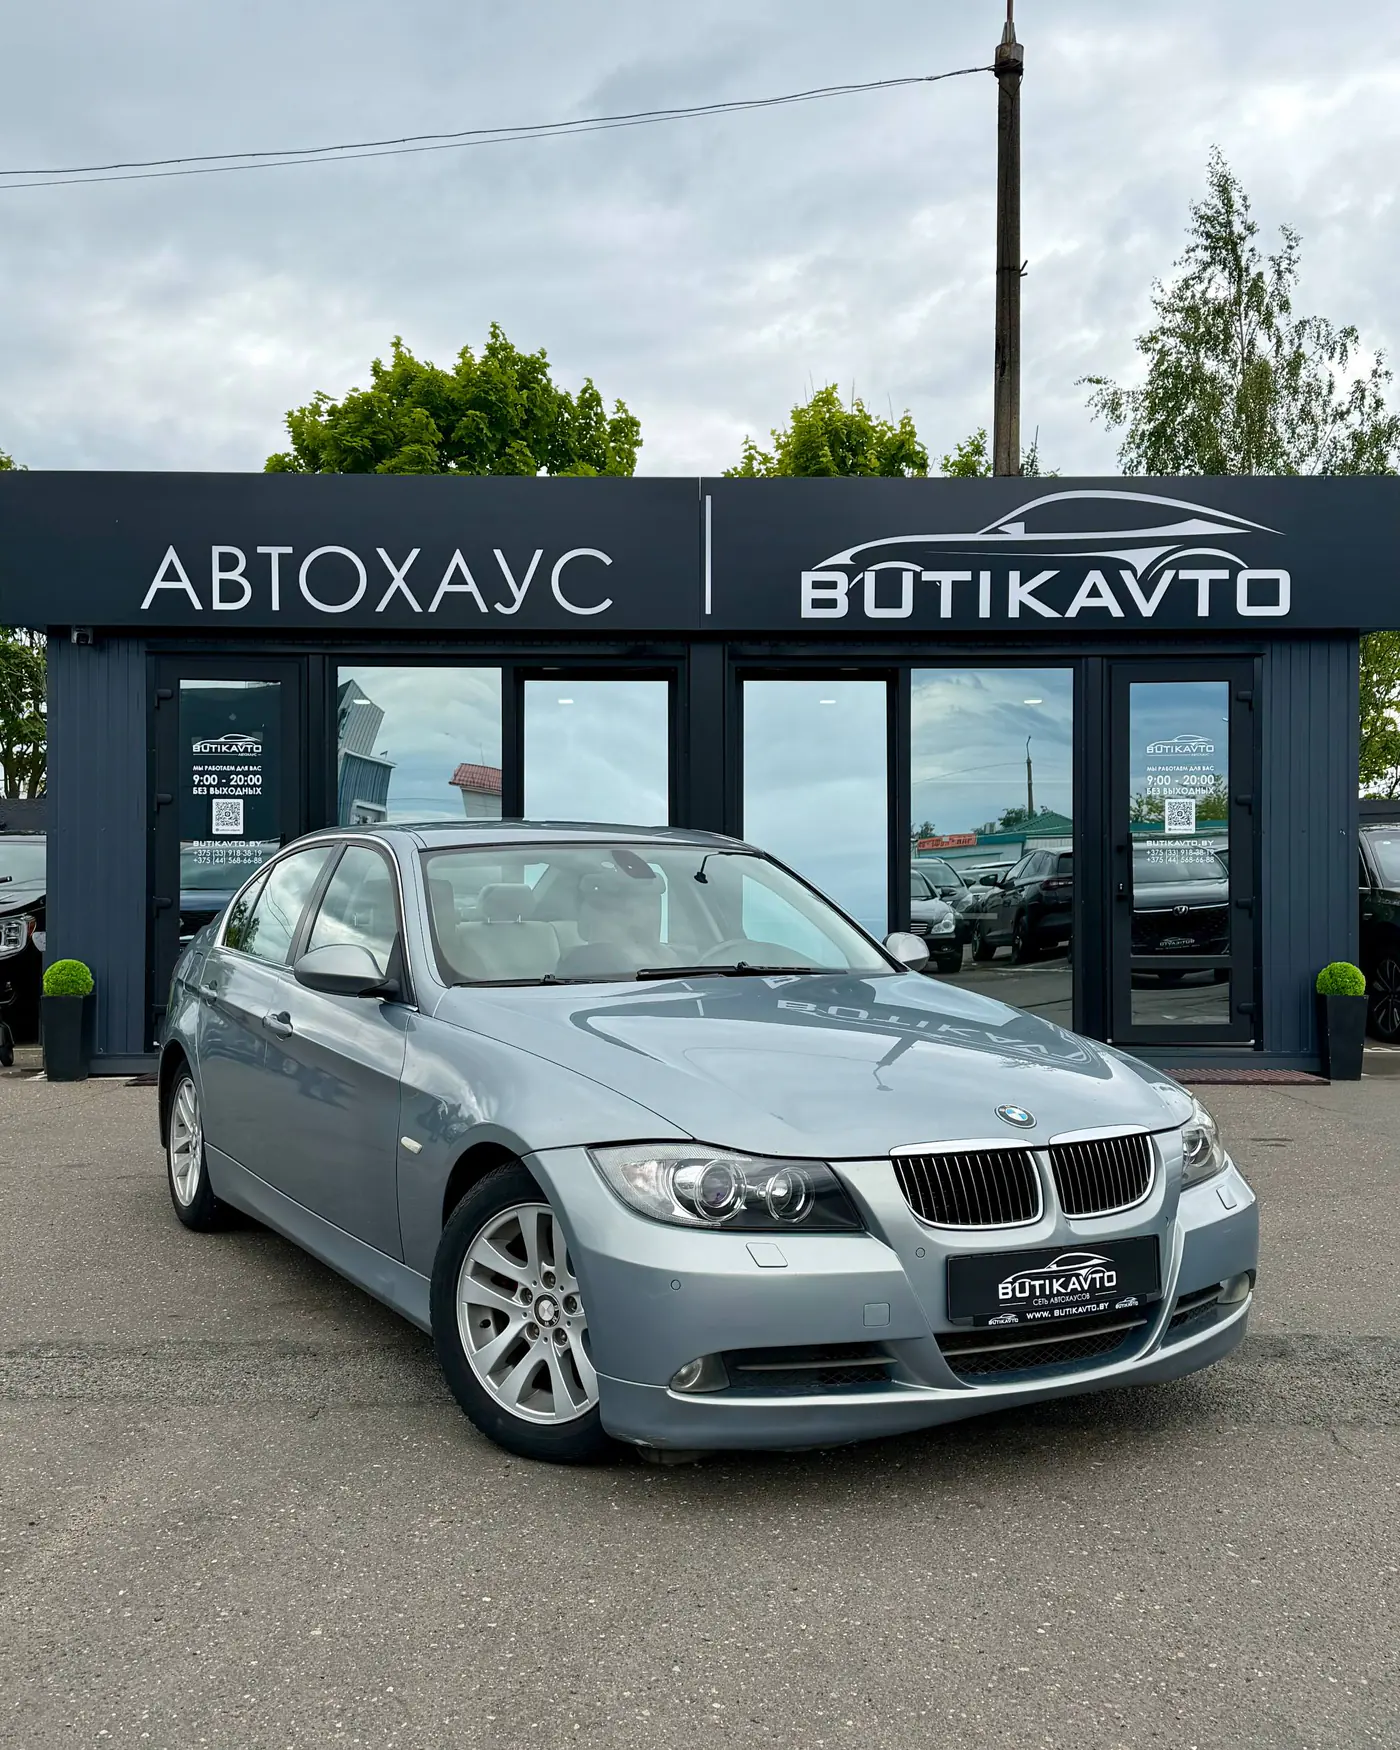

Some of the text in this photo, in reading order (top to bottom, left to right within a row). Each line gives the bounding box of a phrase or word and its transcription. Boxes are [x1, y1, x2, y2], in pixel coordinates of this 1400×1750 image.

[141, 545, 613, 615] АВТОХАУС
[801, 567, 1291, 619] BUTIKAVTO
[192, 744, 262, 753] BUTIKAVTO
[1146, 744, 1215, 753] BUTIKAVTO
[192, 774, 218, 785] 9:00
[229, 774, 262, 785] 20:00
[1146, 775, 1171, 786] 9:00
[1183, 774, 1215, 785] 20:00
[192, 787, 262, 795] БЕЗ ВЫХОДНЫХ
[1146, 787, 1215, 795] БЕЗ ВЫХОДНЫХ
[227, 849, 262, 857] 918-38-19
[998, 1271, 1117, 1300] BUTIKAVTO
[1033, 1292, 1090, 1306] СЕТЬ АВТОХАУСОВ
[1054, 1302, 1110, 1317] BUTIKAVTO.BY
